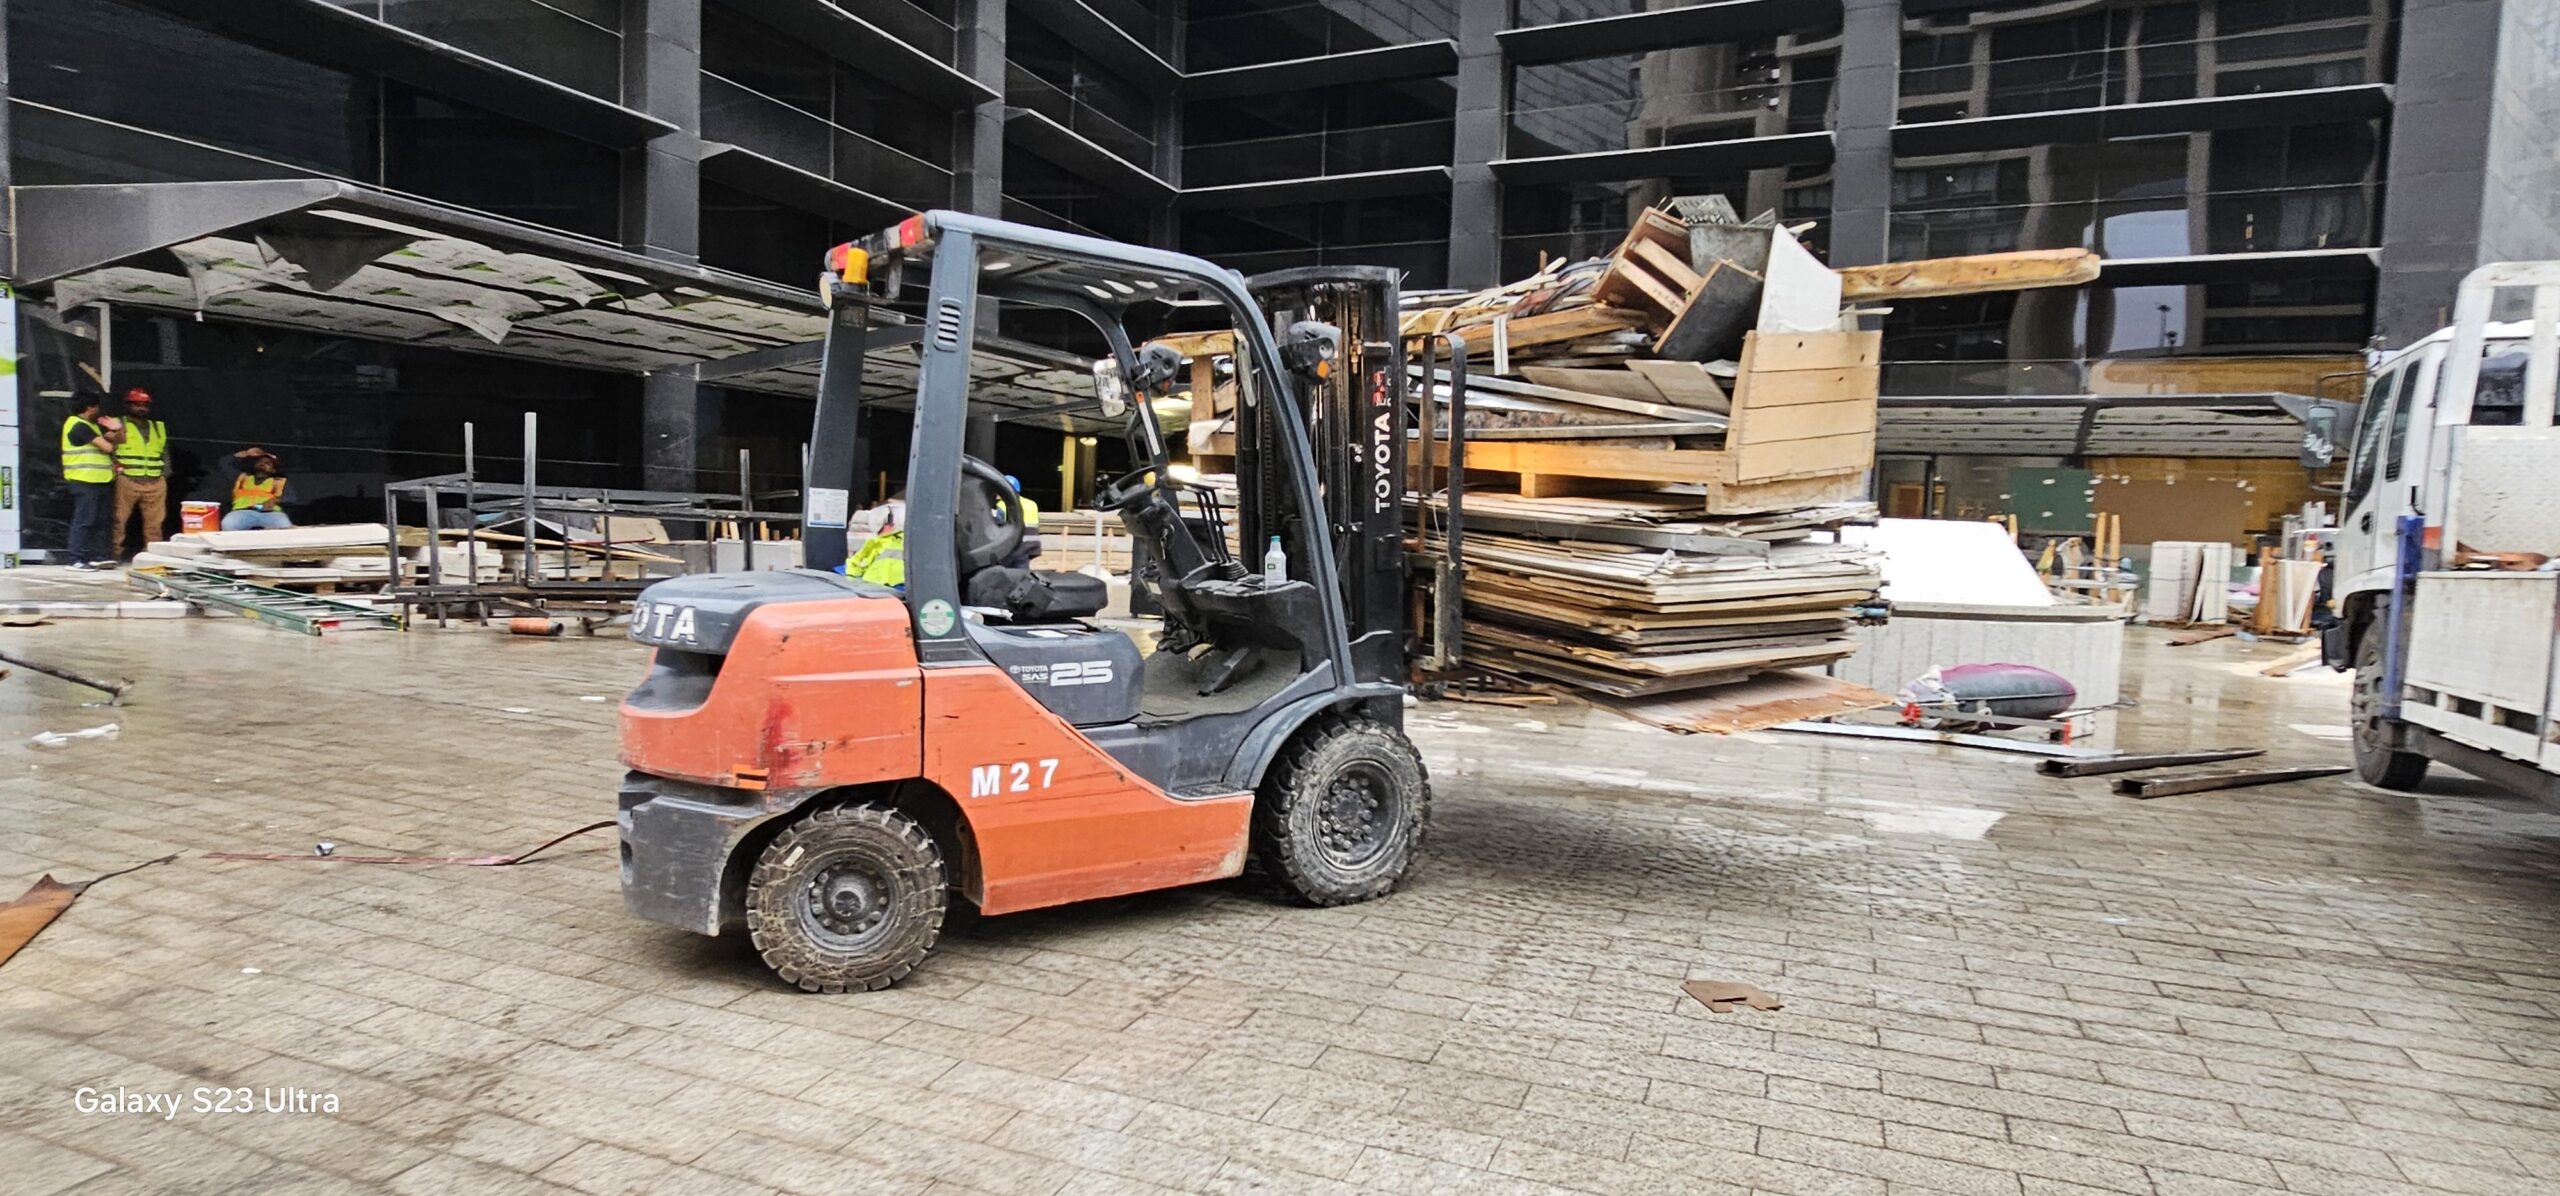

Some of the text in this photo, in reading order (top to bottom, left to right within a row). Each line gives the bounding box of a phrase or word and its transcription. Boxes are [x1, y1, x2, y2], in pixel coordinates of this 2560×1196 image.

[1374, 412, 1391, 514] TOYOTA
[1021, 664, 1048, 673] TOYOTA
[1021, 672, 1048, 681] SAS
[1050, 659, 1114, 687] 25
